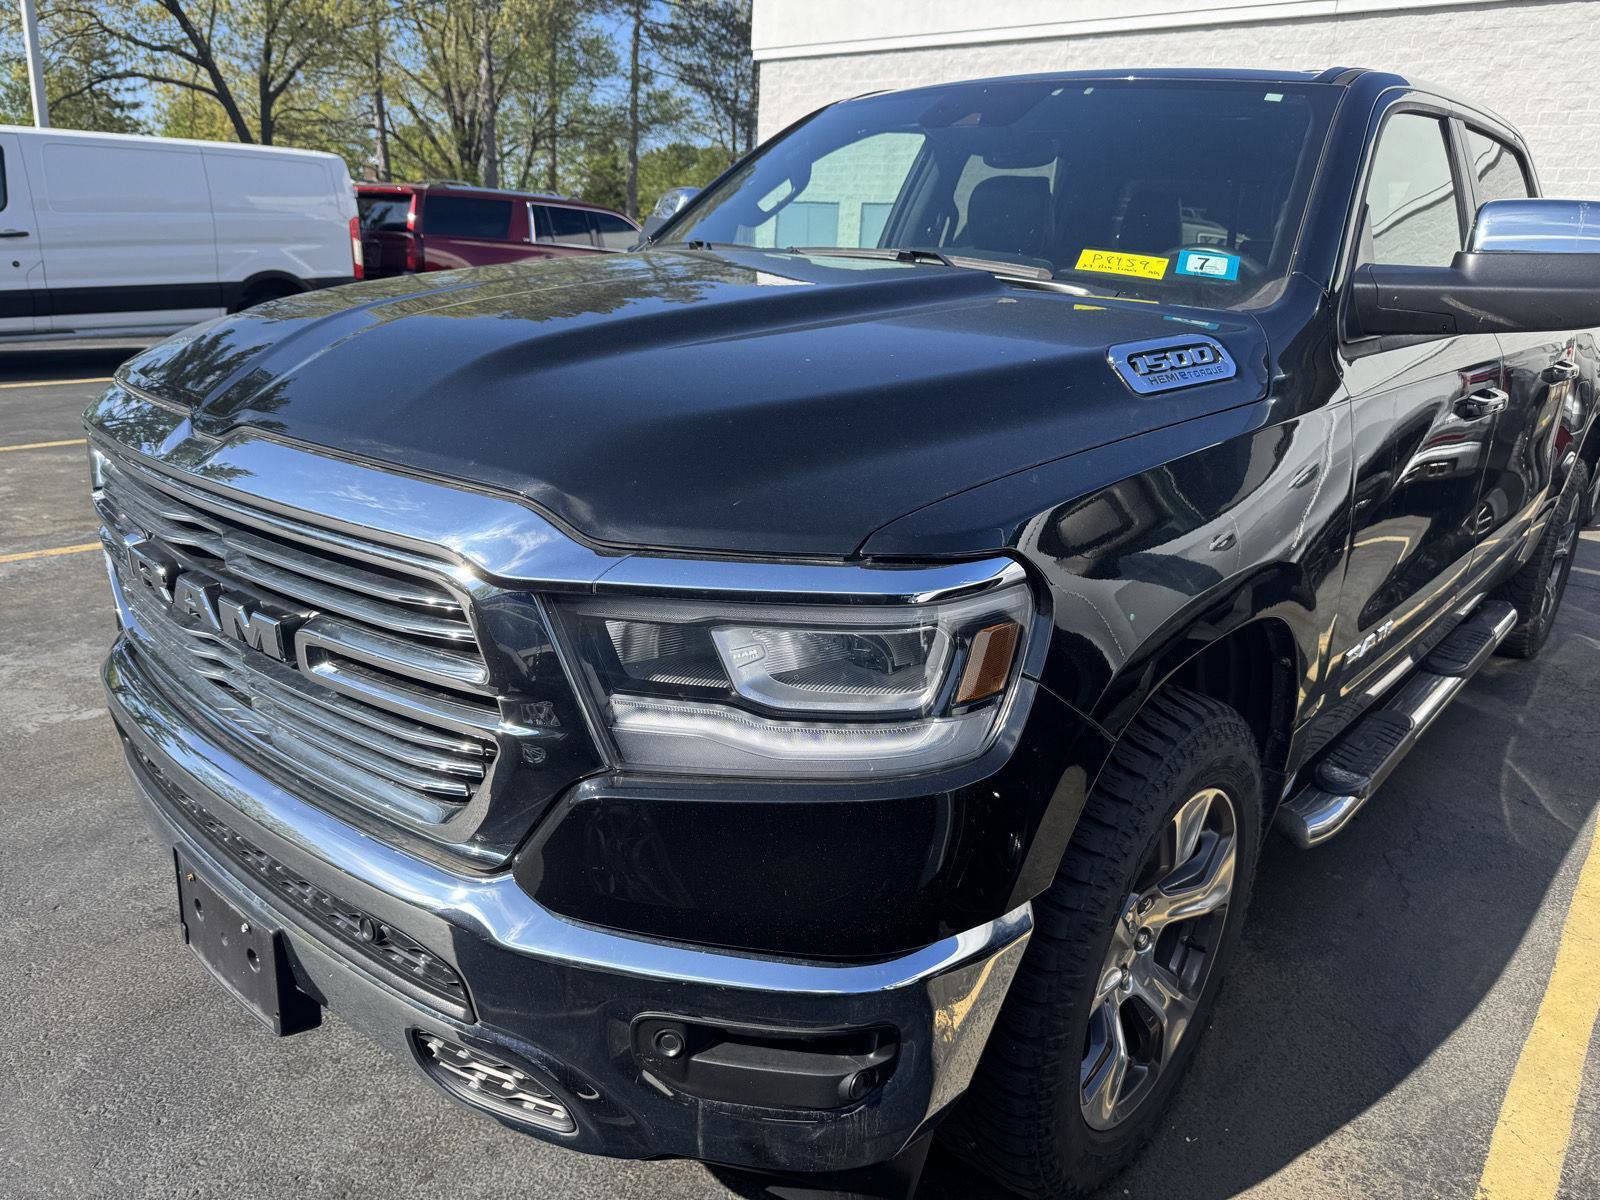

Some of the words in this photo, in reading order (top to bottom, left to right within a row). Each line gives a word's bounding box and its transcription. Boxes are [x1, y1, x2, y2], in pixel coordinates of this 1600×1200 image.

[1197, 256, 1211, 271] 7
[1130, 346, 1215, 376] 1500
[1148, 373, 1181, 386] HEMI
[125, 540, 290, 664] RAM
